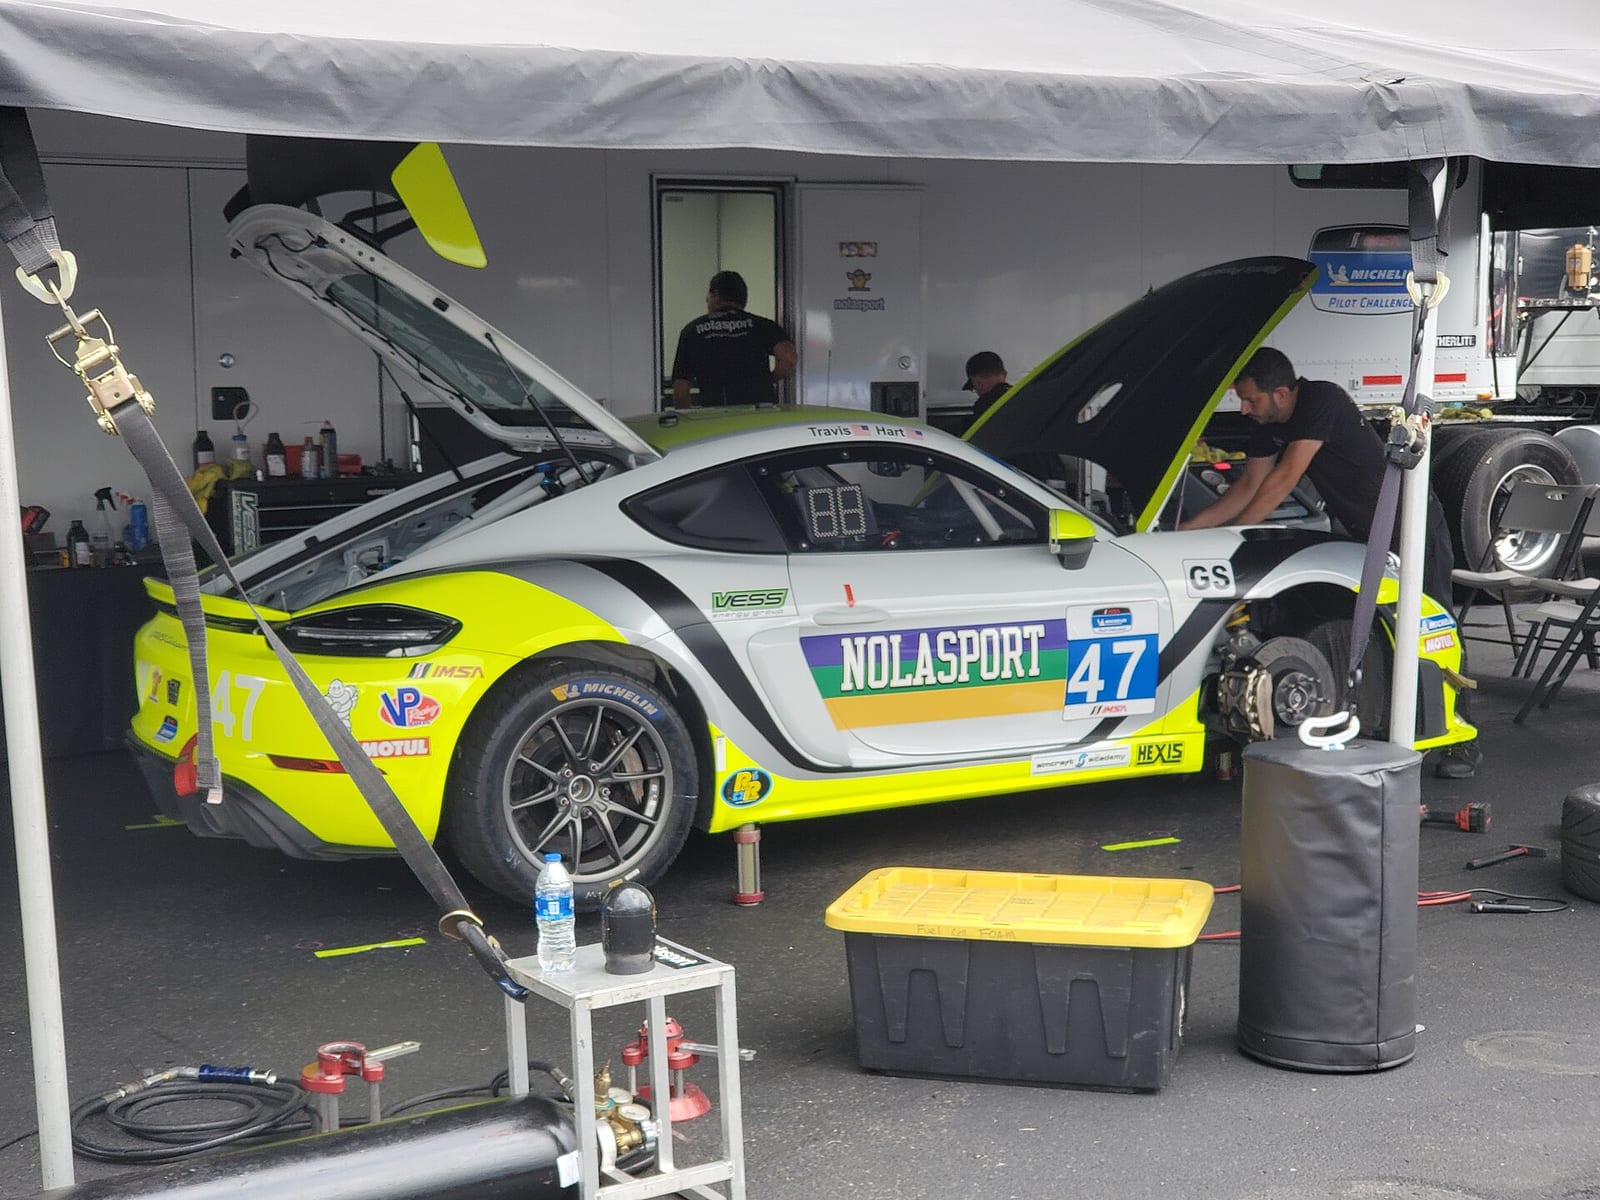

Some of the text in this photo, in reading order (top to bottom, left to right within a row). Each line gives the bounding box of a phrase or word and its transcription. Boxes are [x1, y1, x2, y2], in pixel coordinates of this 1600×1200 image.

[1350, 269, 1409, 280] MICHELI
[1329, 297, 1358, 308] PILOT
[696, 319, 753, 334] nolasport
[808, 426, 906, 437] Travis Hart
[1190, 565, 1230, 590] GS
[715, 592, 785, 608] VESS
[839, 624, 1045, 692] NOLASPORT
[432, 665, 485, 678] IMSA
[1067, 640, 1147, 703] 47
[210, 670, 265, 741] 47
[583, 683, 658, 715] MICHELIN
[361, 739, 429, 758] MOTUL
[1137, 743, 1183, 765] HEXIS
